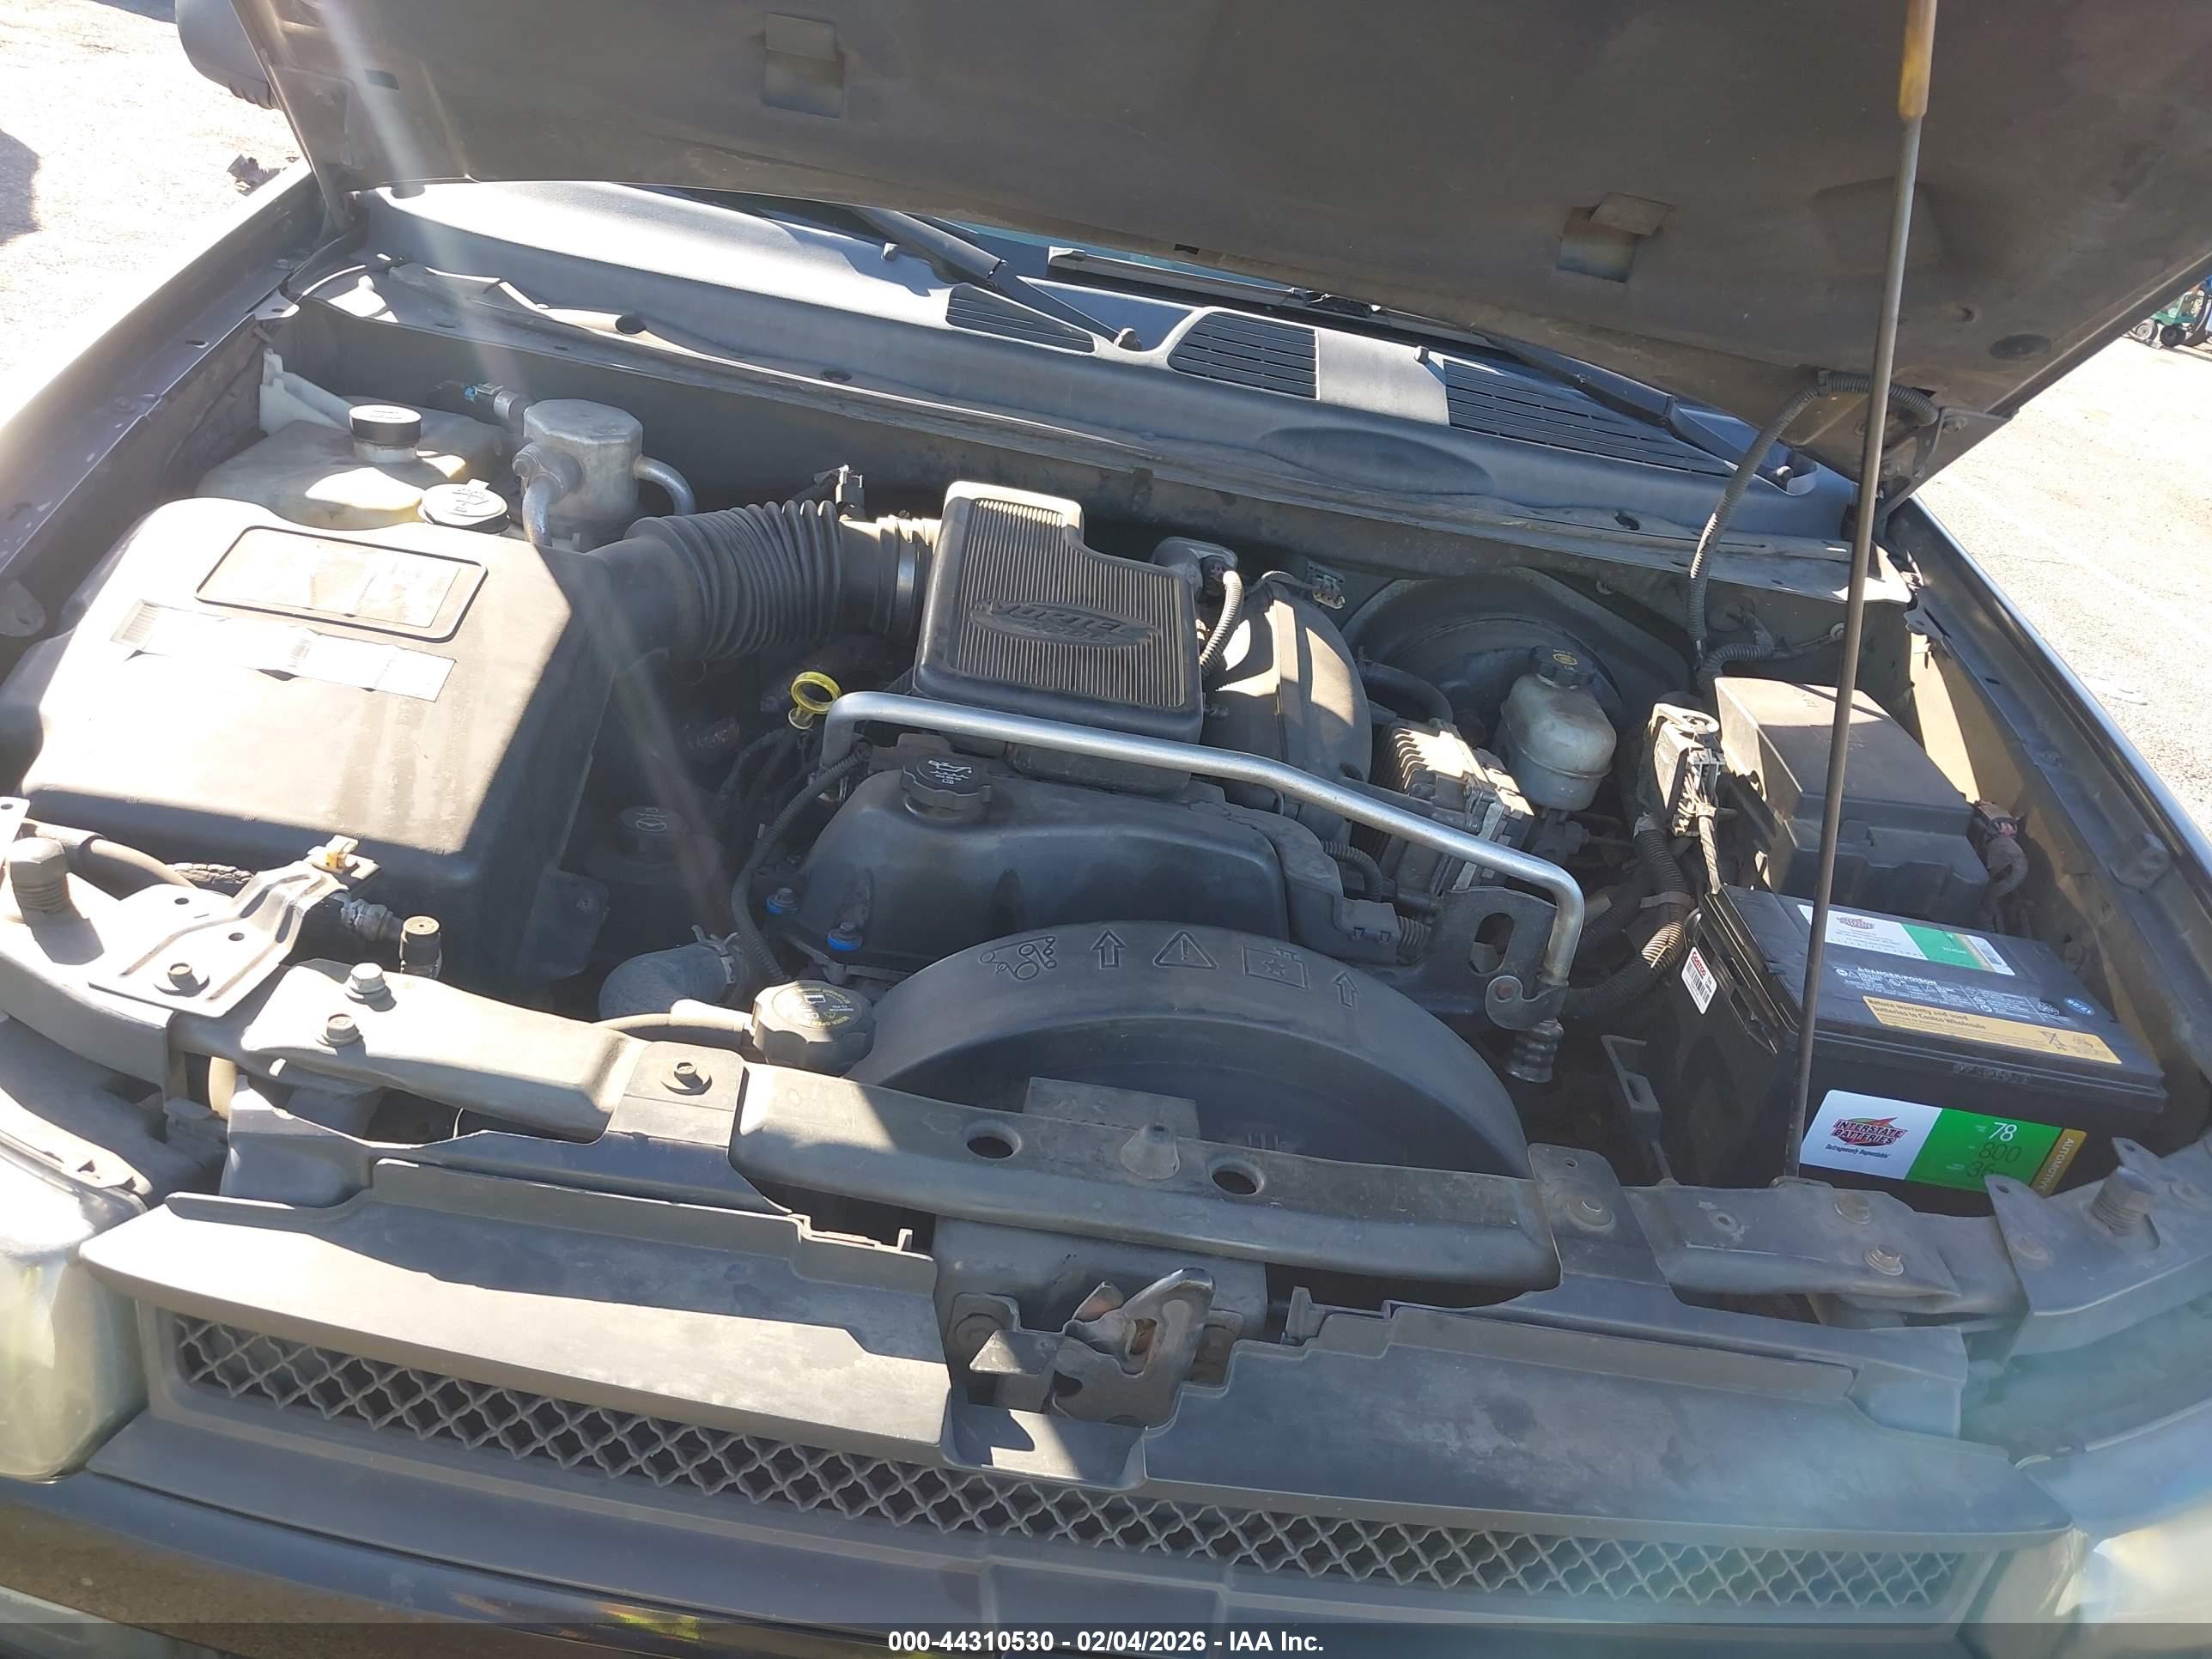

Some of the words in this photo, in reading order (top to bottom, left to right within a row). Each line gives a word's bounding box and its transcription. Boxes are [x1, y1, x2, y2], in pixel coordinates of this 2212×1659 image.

[1832, 1129, 1894, 1146] BATTERIES
[1834, 1120, 1904, 1139] INTERSTATE
[1988, 1121, 2018, 1142] 78
[1978, 1141, 2021, 1164] 800
